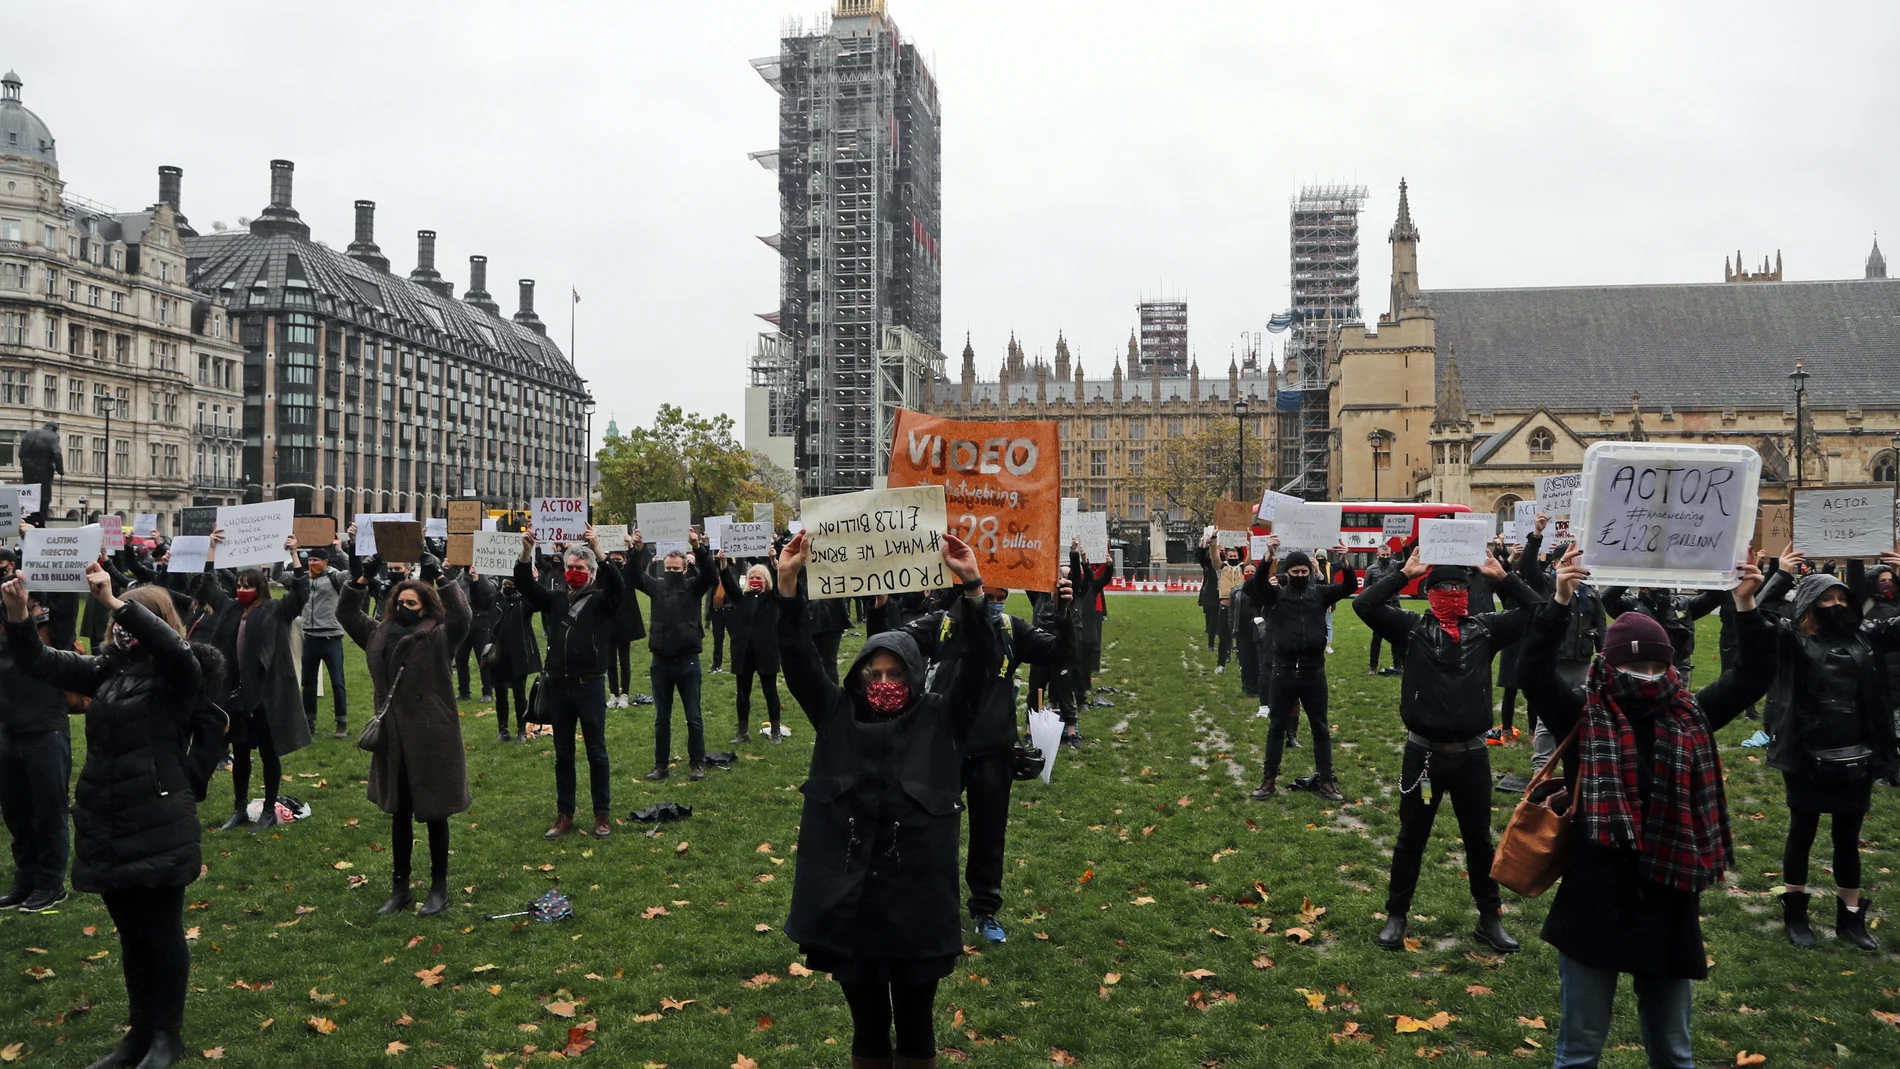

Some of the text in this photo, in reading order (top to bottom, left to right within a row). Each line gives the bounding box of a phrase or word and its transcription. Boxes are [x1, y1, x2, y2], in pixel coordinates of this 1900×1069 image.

[908, 430, 1038, 477] VIDEO
[1544, 474, 1582, 492] ACTOR
[1542, 490, 1573, 499] #whatweb
[1610, 466, 1734, 516] ACTOR
[452, 503, 475, 512] ACTOR
[540, 500, 583, 512] ACTOR
[653, 502, 677, 512] ACTOR
[1518, 503, 1537, 515] ACT
[1823, 497, 1868, 510] ACTOR
[1062, 507, 1072, 516] OR
[1292, 509, 1326, 517] ACTOR
[1773, 508, 1790, 523] AC
[224, 513, 282, 527] CHOREOGRAPHER
[819, 513, 871, 536] BILLION
[535, 527, 563, 541] £1.28
[728, 524, 762, 533] ACTOR
[1429, 523, 1478, 534] ACTOR
[46, 536, 78, 544] CASTING
[490, 535, 521, 545] ACTOR
[1002, 532, 1041, 550] billion
[1596, 518, 1723, 552] £1.28 BILLION
[810, 530, 941, 563] #WHAT WE BRING
[25, 561, 50, 569] #WHAT
[497, 559, 514, 569] BILL
[818, 563, 944, 595] PRODUCER
